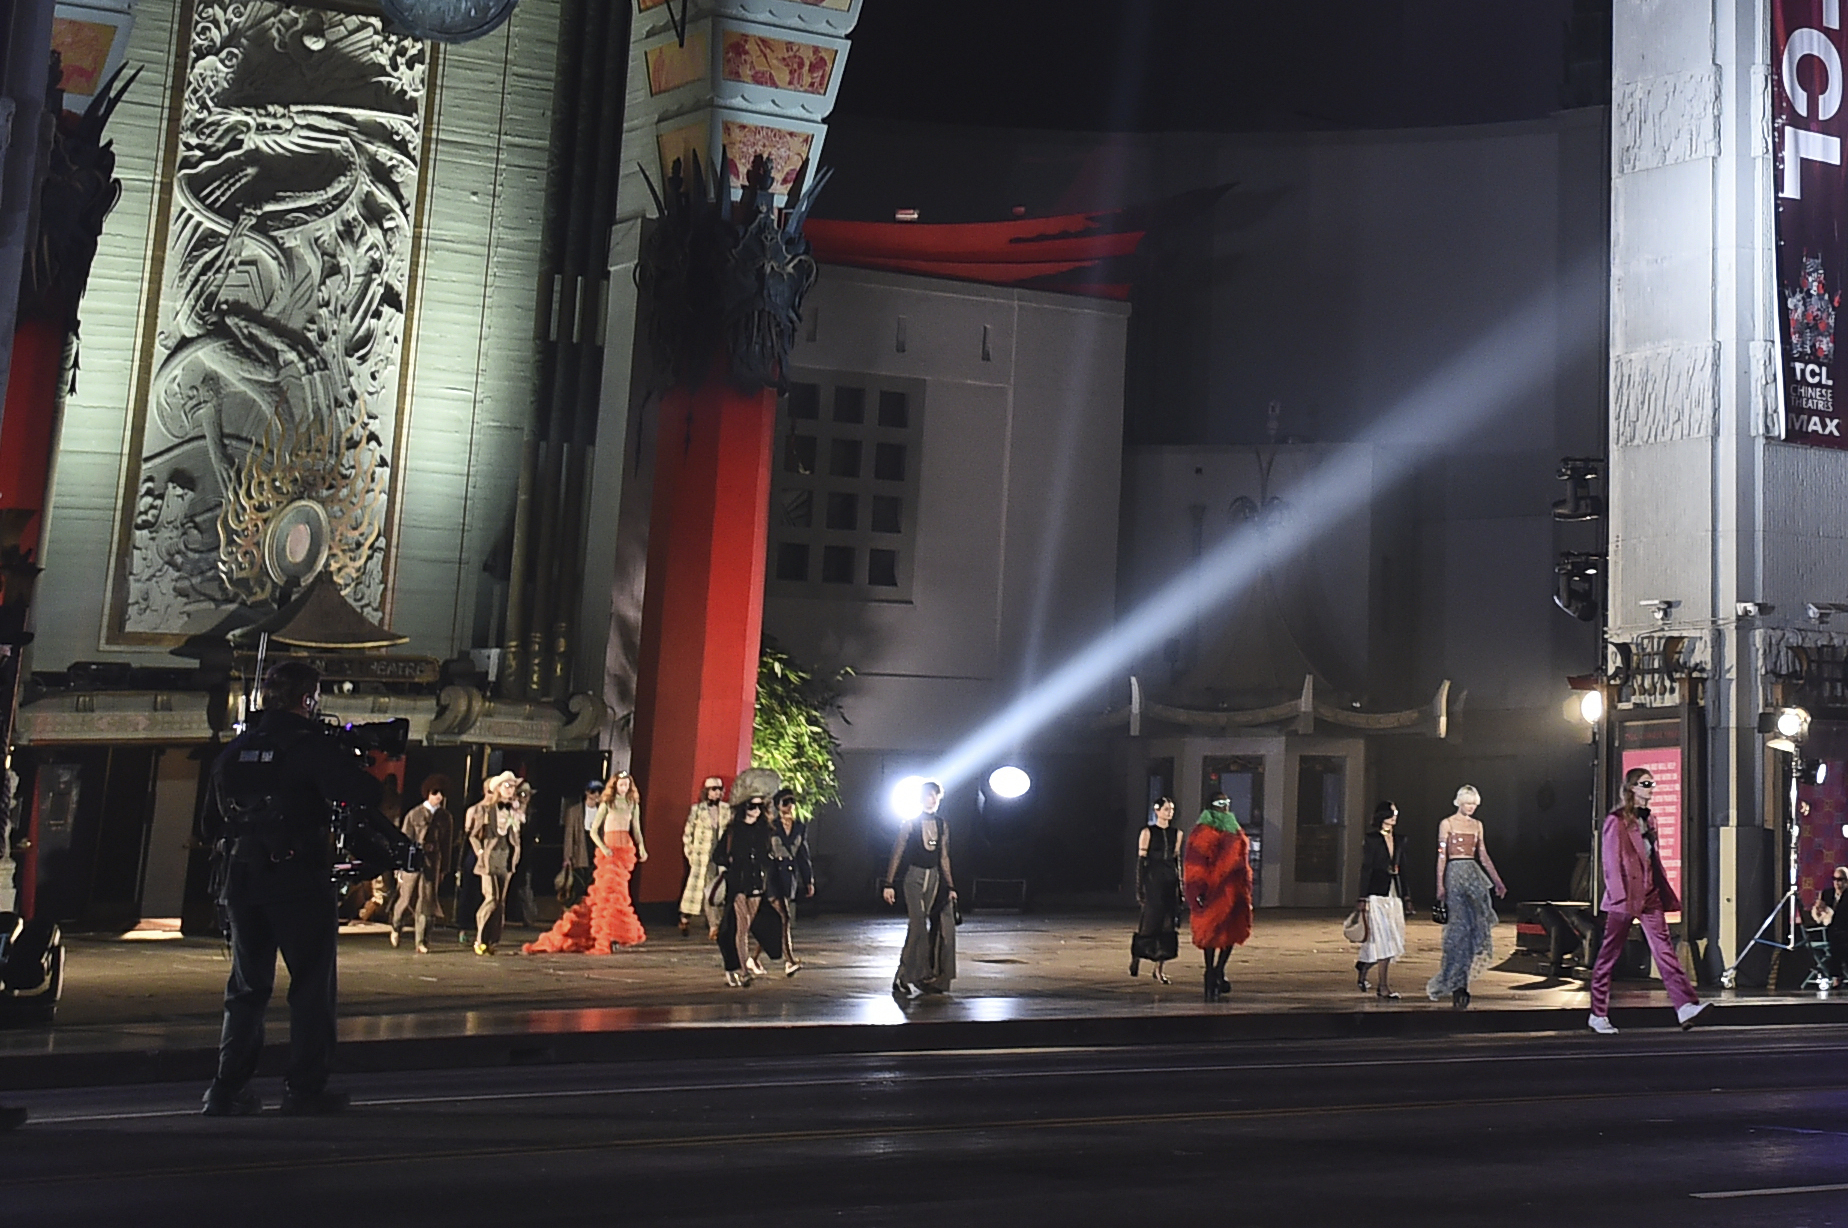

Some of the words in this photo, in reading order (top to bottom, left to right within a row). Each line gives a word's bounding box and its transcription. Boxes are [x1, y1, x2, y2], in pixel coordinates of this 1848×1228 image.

[1790, 361, 1834, 386] TCL
[1790, 384, 1833, 402] CHINESE
[1790, 396, 1833, 412] THEATRES
